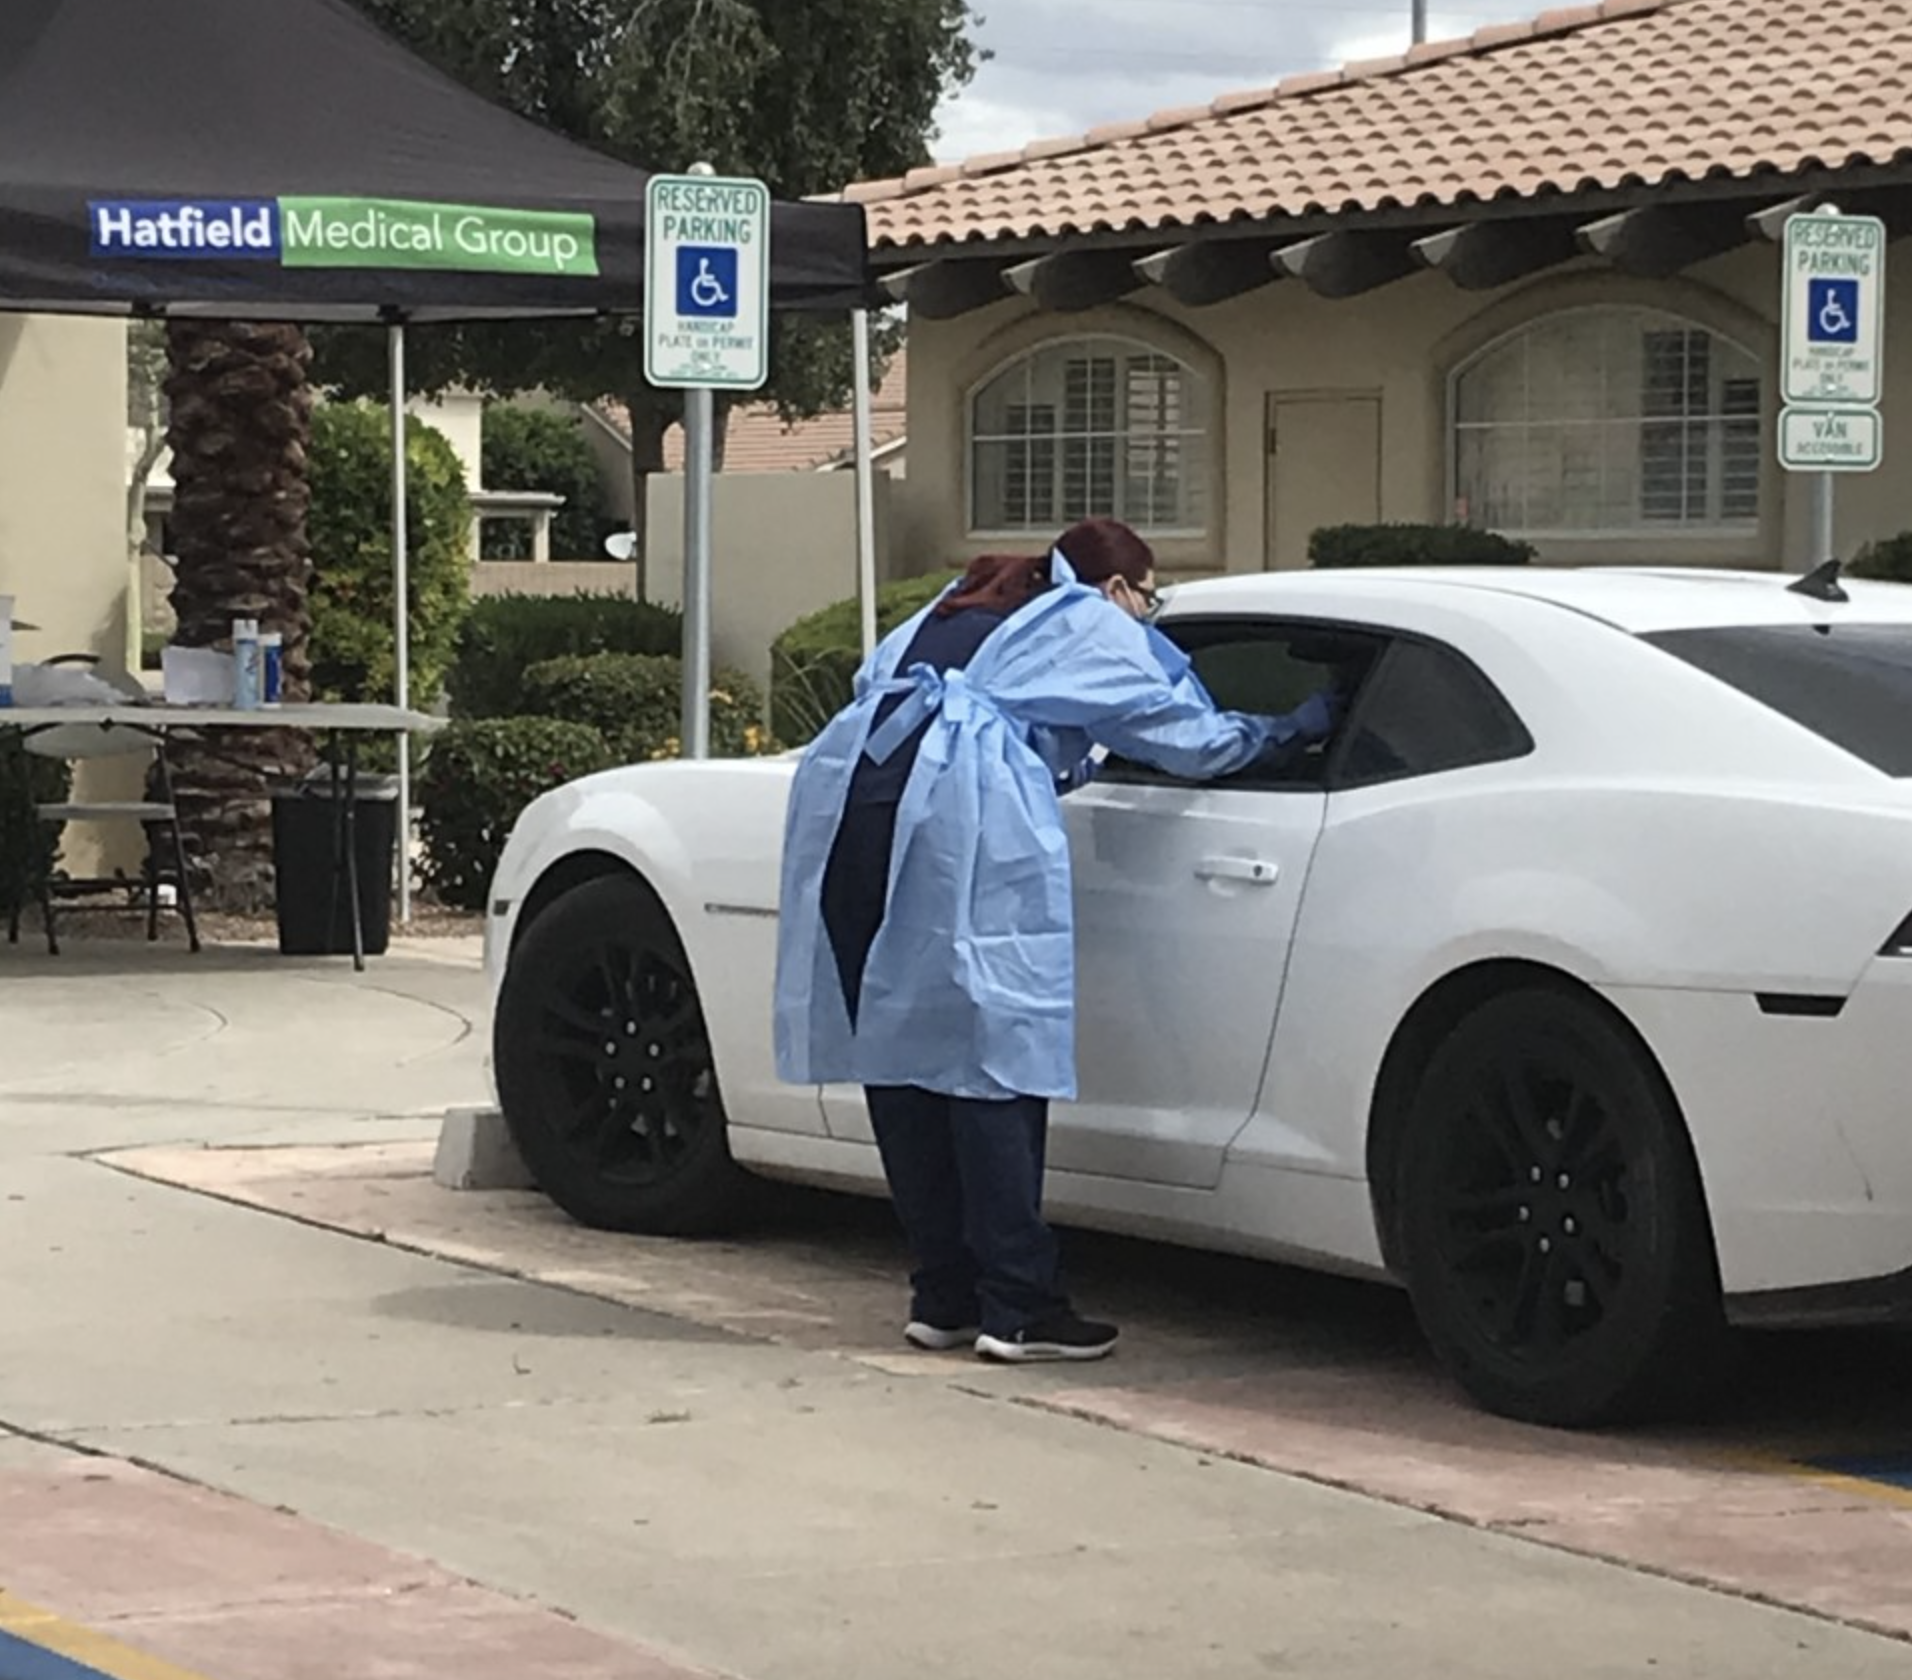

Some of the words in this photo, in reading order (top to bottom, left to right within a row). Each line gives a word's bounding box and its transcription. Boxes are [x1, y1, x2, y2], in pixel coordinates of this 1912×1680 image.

[657, 185, 758, 215] RESERVED
[99, 207, 272, 248] Hatfield
[286, 209, 443, 252] Medical
[455, 215, 579, 270] Group
[663, 215, 752, 244] PARKING
[1792, 224, 1876, 249] RESERVED
[1797, 251, 1870, 276] PARKING
[658, 333, 692, 349] PLATE
[1812, 420, 1847, 439] VAN
